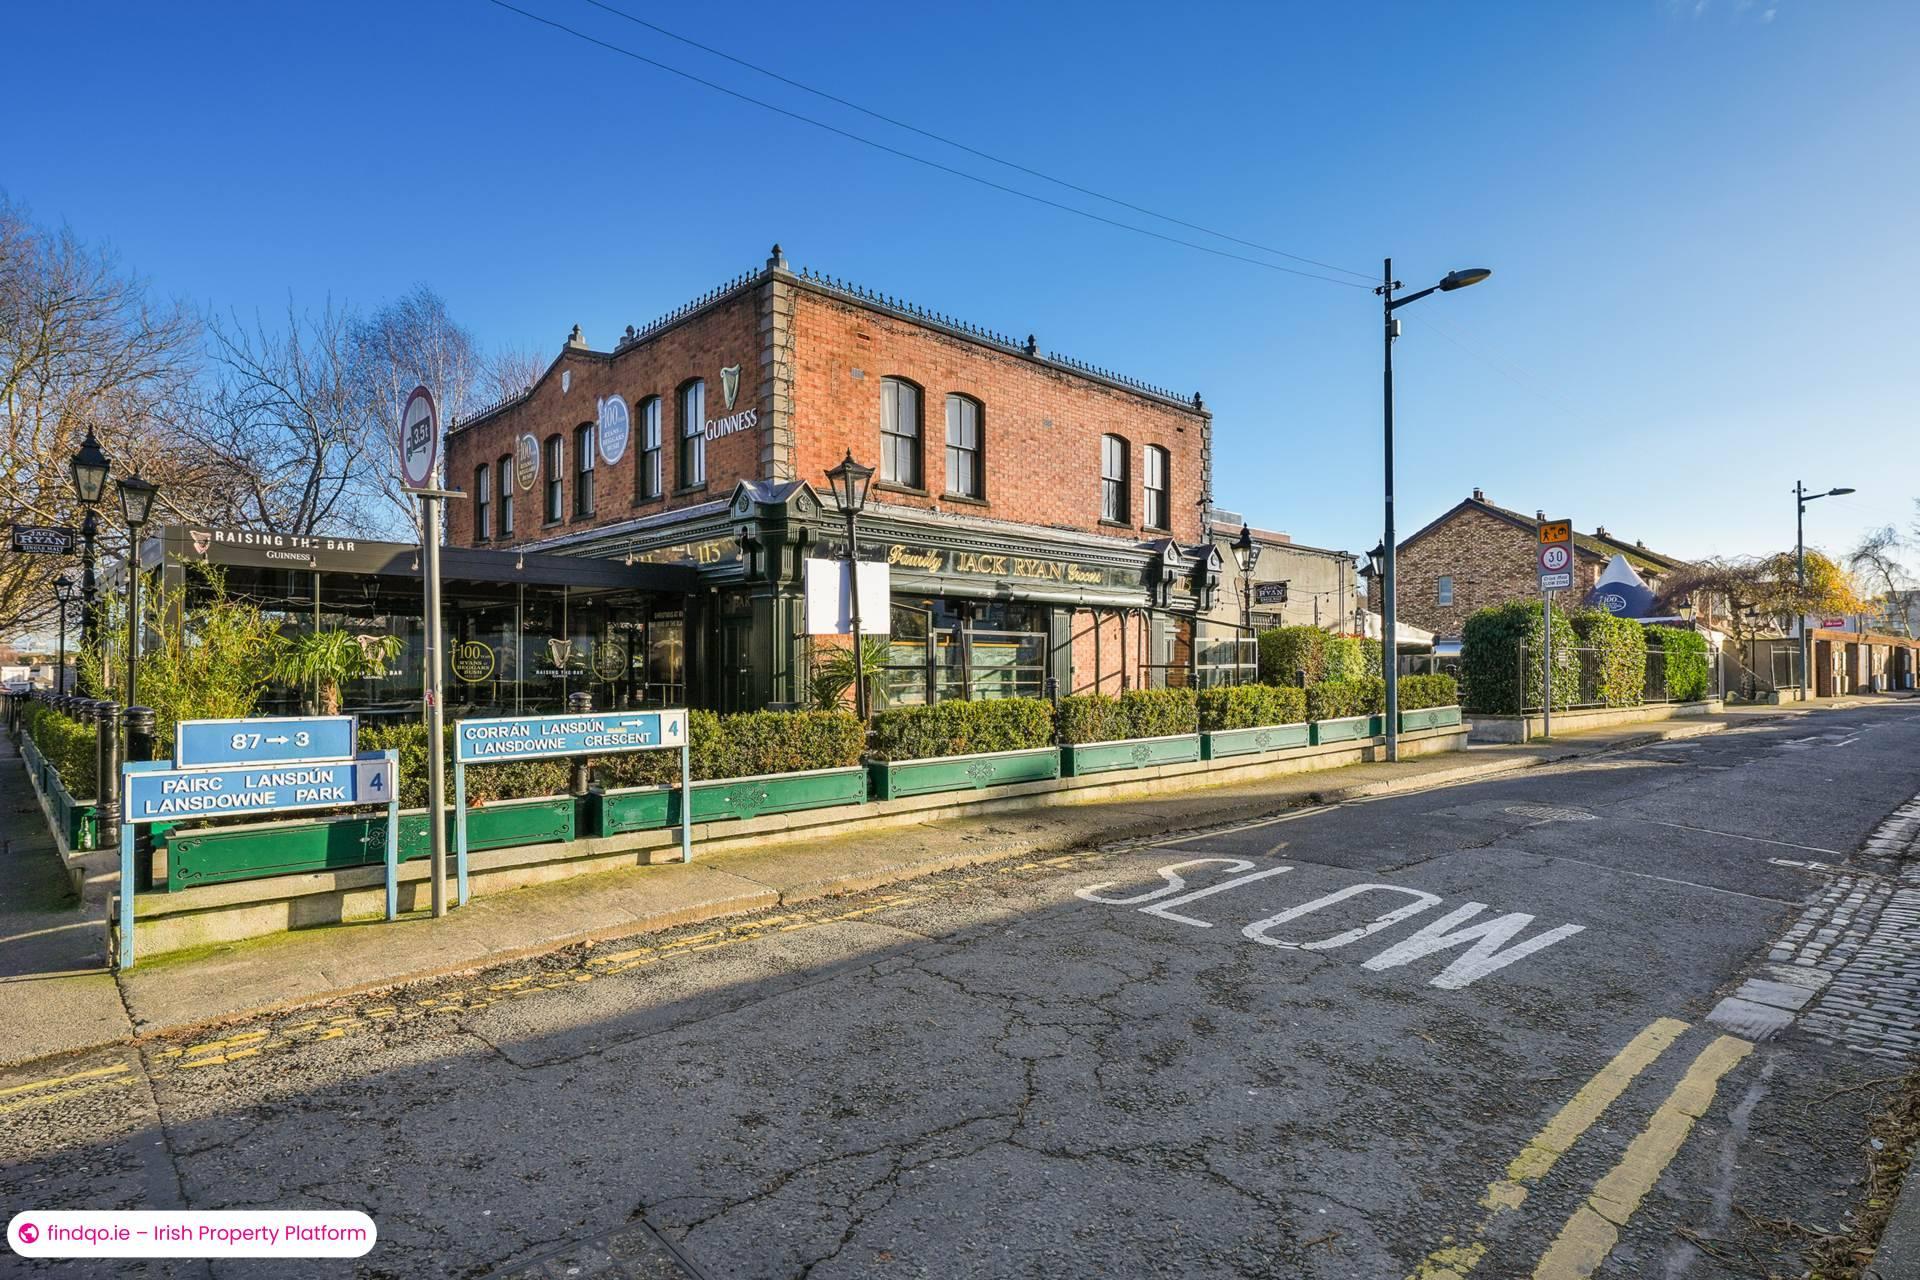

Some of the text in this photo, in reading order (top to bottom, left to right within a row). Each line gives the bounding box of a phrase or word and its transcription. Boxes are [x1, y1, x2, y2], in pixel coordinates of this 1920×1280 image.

[413, 424, 429, 445] 3.5t
[705, 408, 758, 440] GUINNESS
[20, 535, 67, 545] RYAN
[215, 531, 283, 546] RAISING
[327, 540, 355, 551] BAR
[266, 551, 311, 561] GUINNESS
[698, 543, 721, 564] 115
[888, 544, 942, 573] Family
[957, 552, 1008, 575] JACK
[1012, 558, 1063, 580] RYAN
[1548, 551, 1563, 562] 30
[460, 644, 480, 659] 100
[465, 719, 604, 740] CORRÁN LANSDÚN
[668, 720, 679, 737] 4
[231, 731, 310, 750] 87 3
[474, 732, 652, 755] LANSDOWNE CRESCENT
[161, 768, 334, 794] PÁIRC LANSDÚN
[370, 772, 383, 792] 4
[145, 786, 345, 814] LANSDOWNE PARK
[1074, 858, 1586, 990] SLOW
